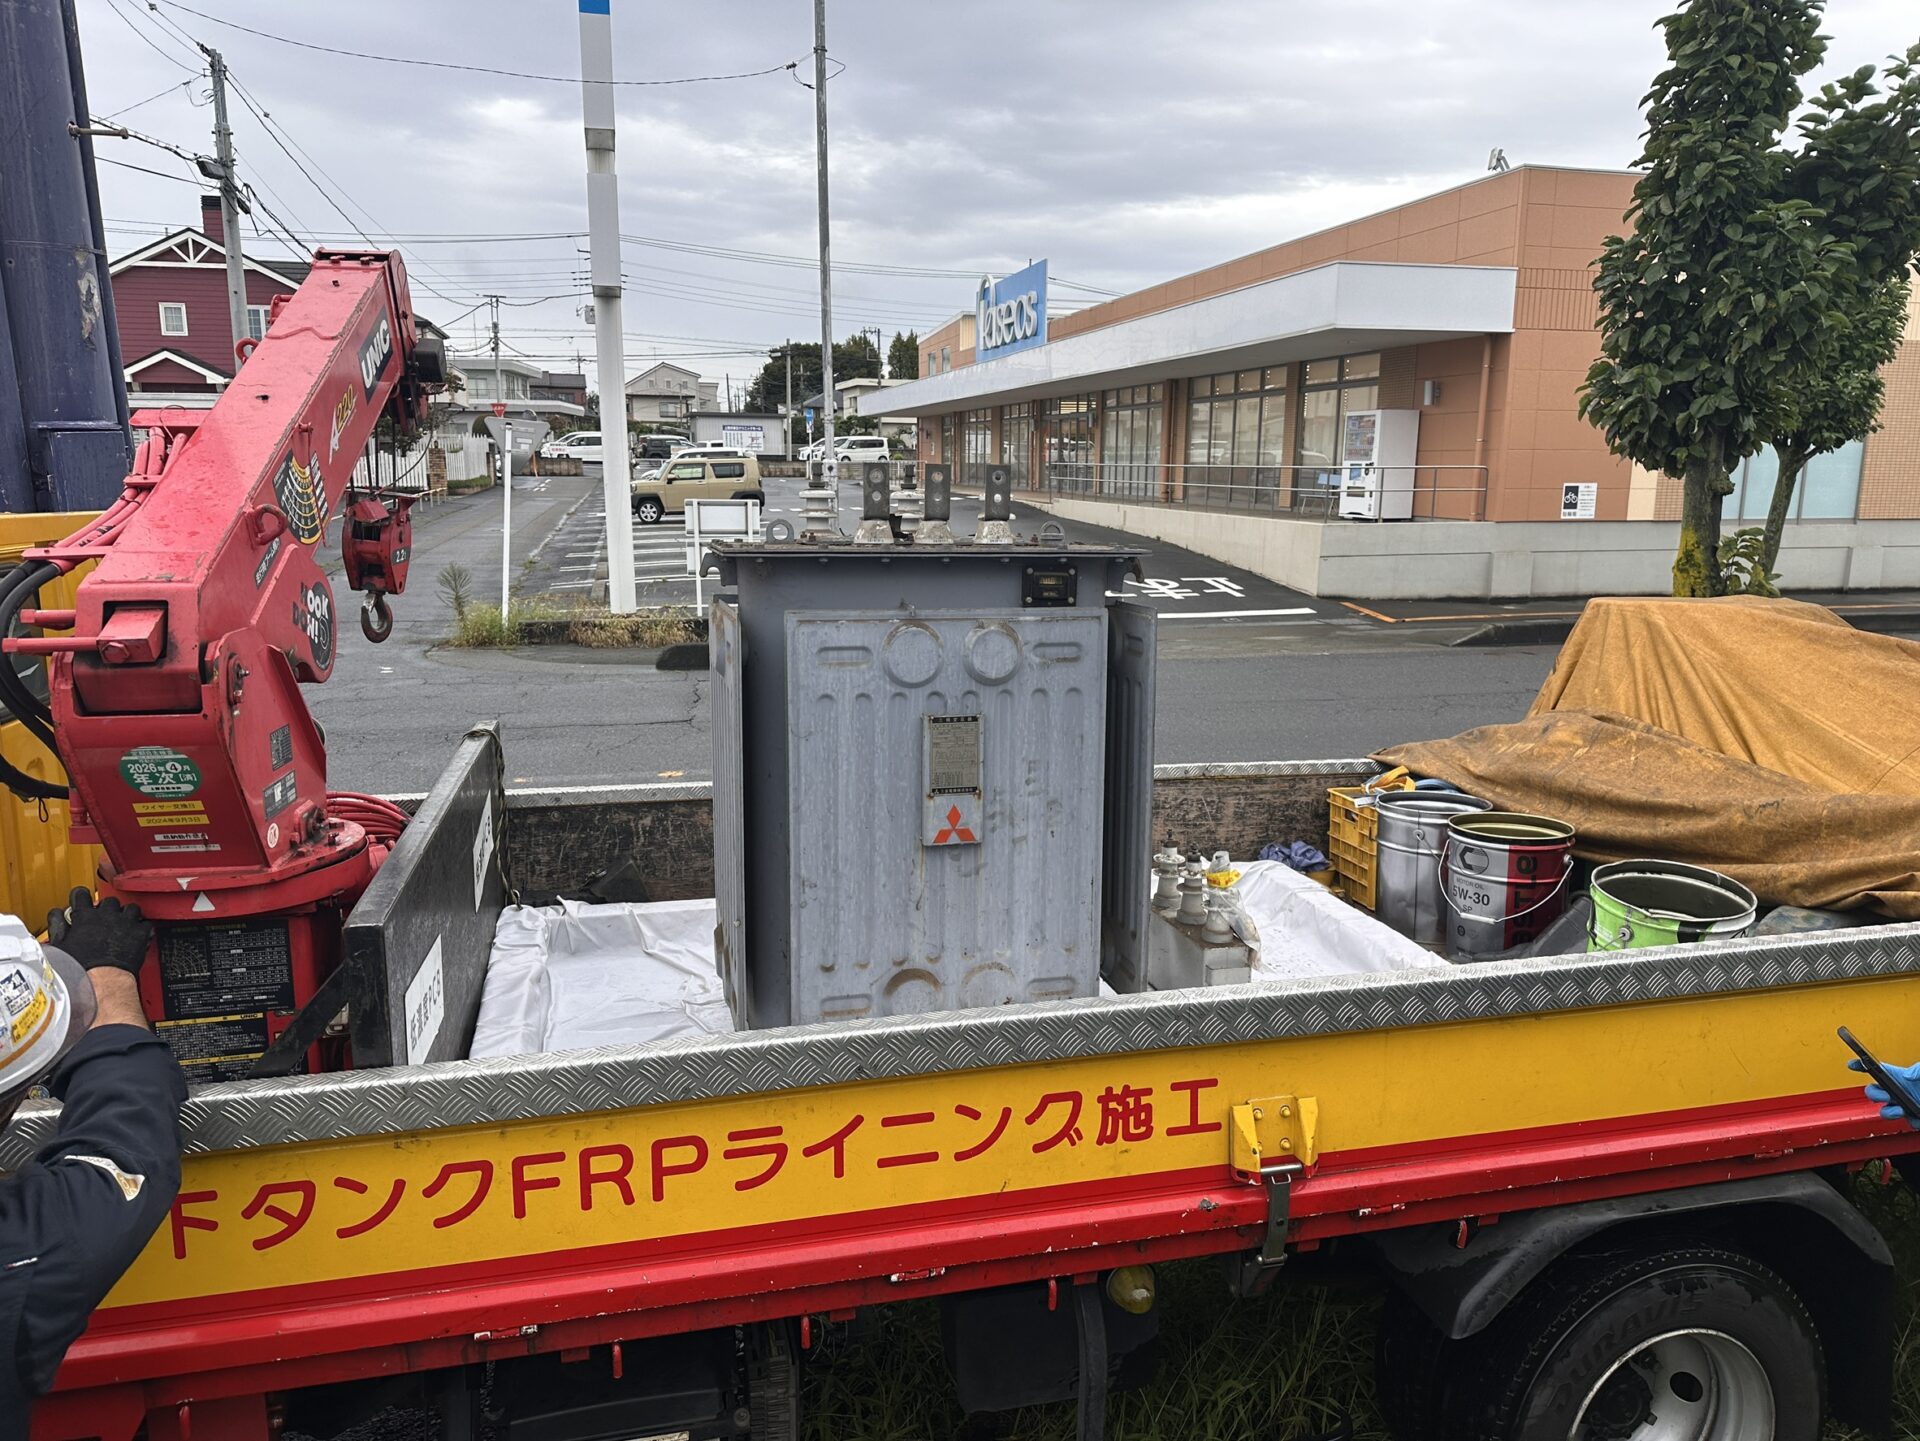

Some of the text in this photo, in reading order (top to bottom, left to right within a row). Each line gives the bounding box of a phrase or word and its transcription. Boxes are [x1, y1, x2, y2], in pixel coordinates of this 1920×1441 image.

[361, 319, 390, 389] UNIC
[142, 803, 196, 811] ワイヤー交換日
[146, 816, 201, 824] 2024年9月3日
[1452, 885, 1490, 906] 5W-30
[1462, 904, 1473, 913] SP
[410, 968, 442, 1051] 低濃度PCB
